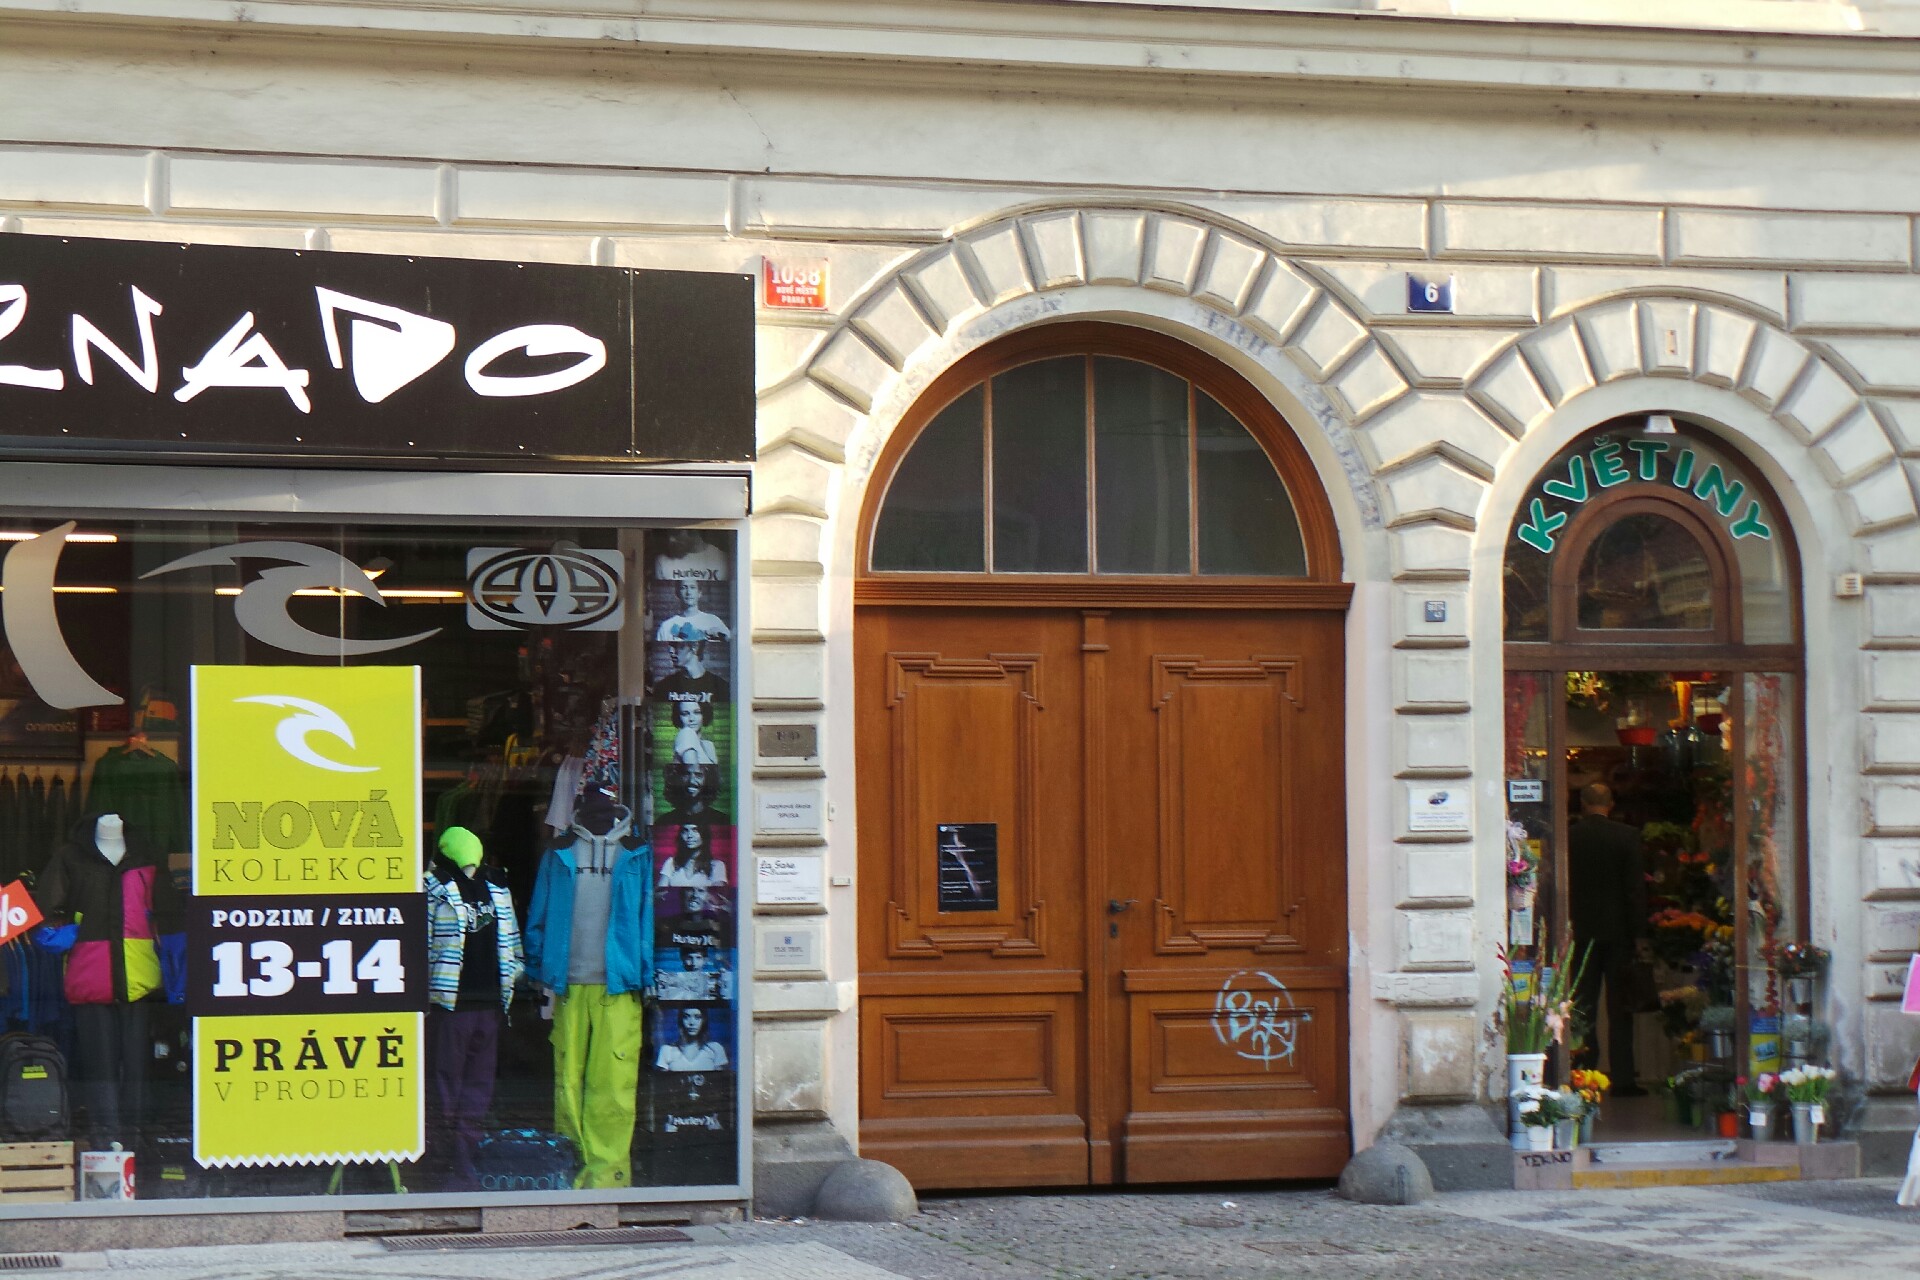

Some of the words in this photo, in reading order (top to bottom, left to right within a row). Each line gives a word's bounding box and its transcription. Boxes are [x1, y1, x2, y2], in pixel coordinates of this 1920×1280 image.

[1424, 282, 1439, 303] 6
[1518, 435, 1772, 554] KVĚTINY
[672, 568, 706, 579] Hurley
[668, 691, 700, 702] Hurley
[211, 789, 403, 850] NOVÁ
[212, 857, 404, 882] KOLEKCE
[212, 908, 314, 928] PODZIM
[320, 908, 331, 927] /
[337, 907, 405, 926] ZIMA
[212, 938, 405, 997] 13-14
[214, 1026, 405, 1072] PRÁVĚ
[214, 1081, 233, 1102] V
[254, 1077, 405, 1101] PRODEJI
